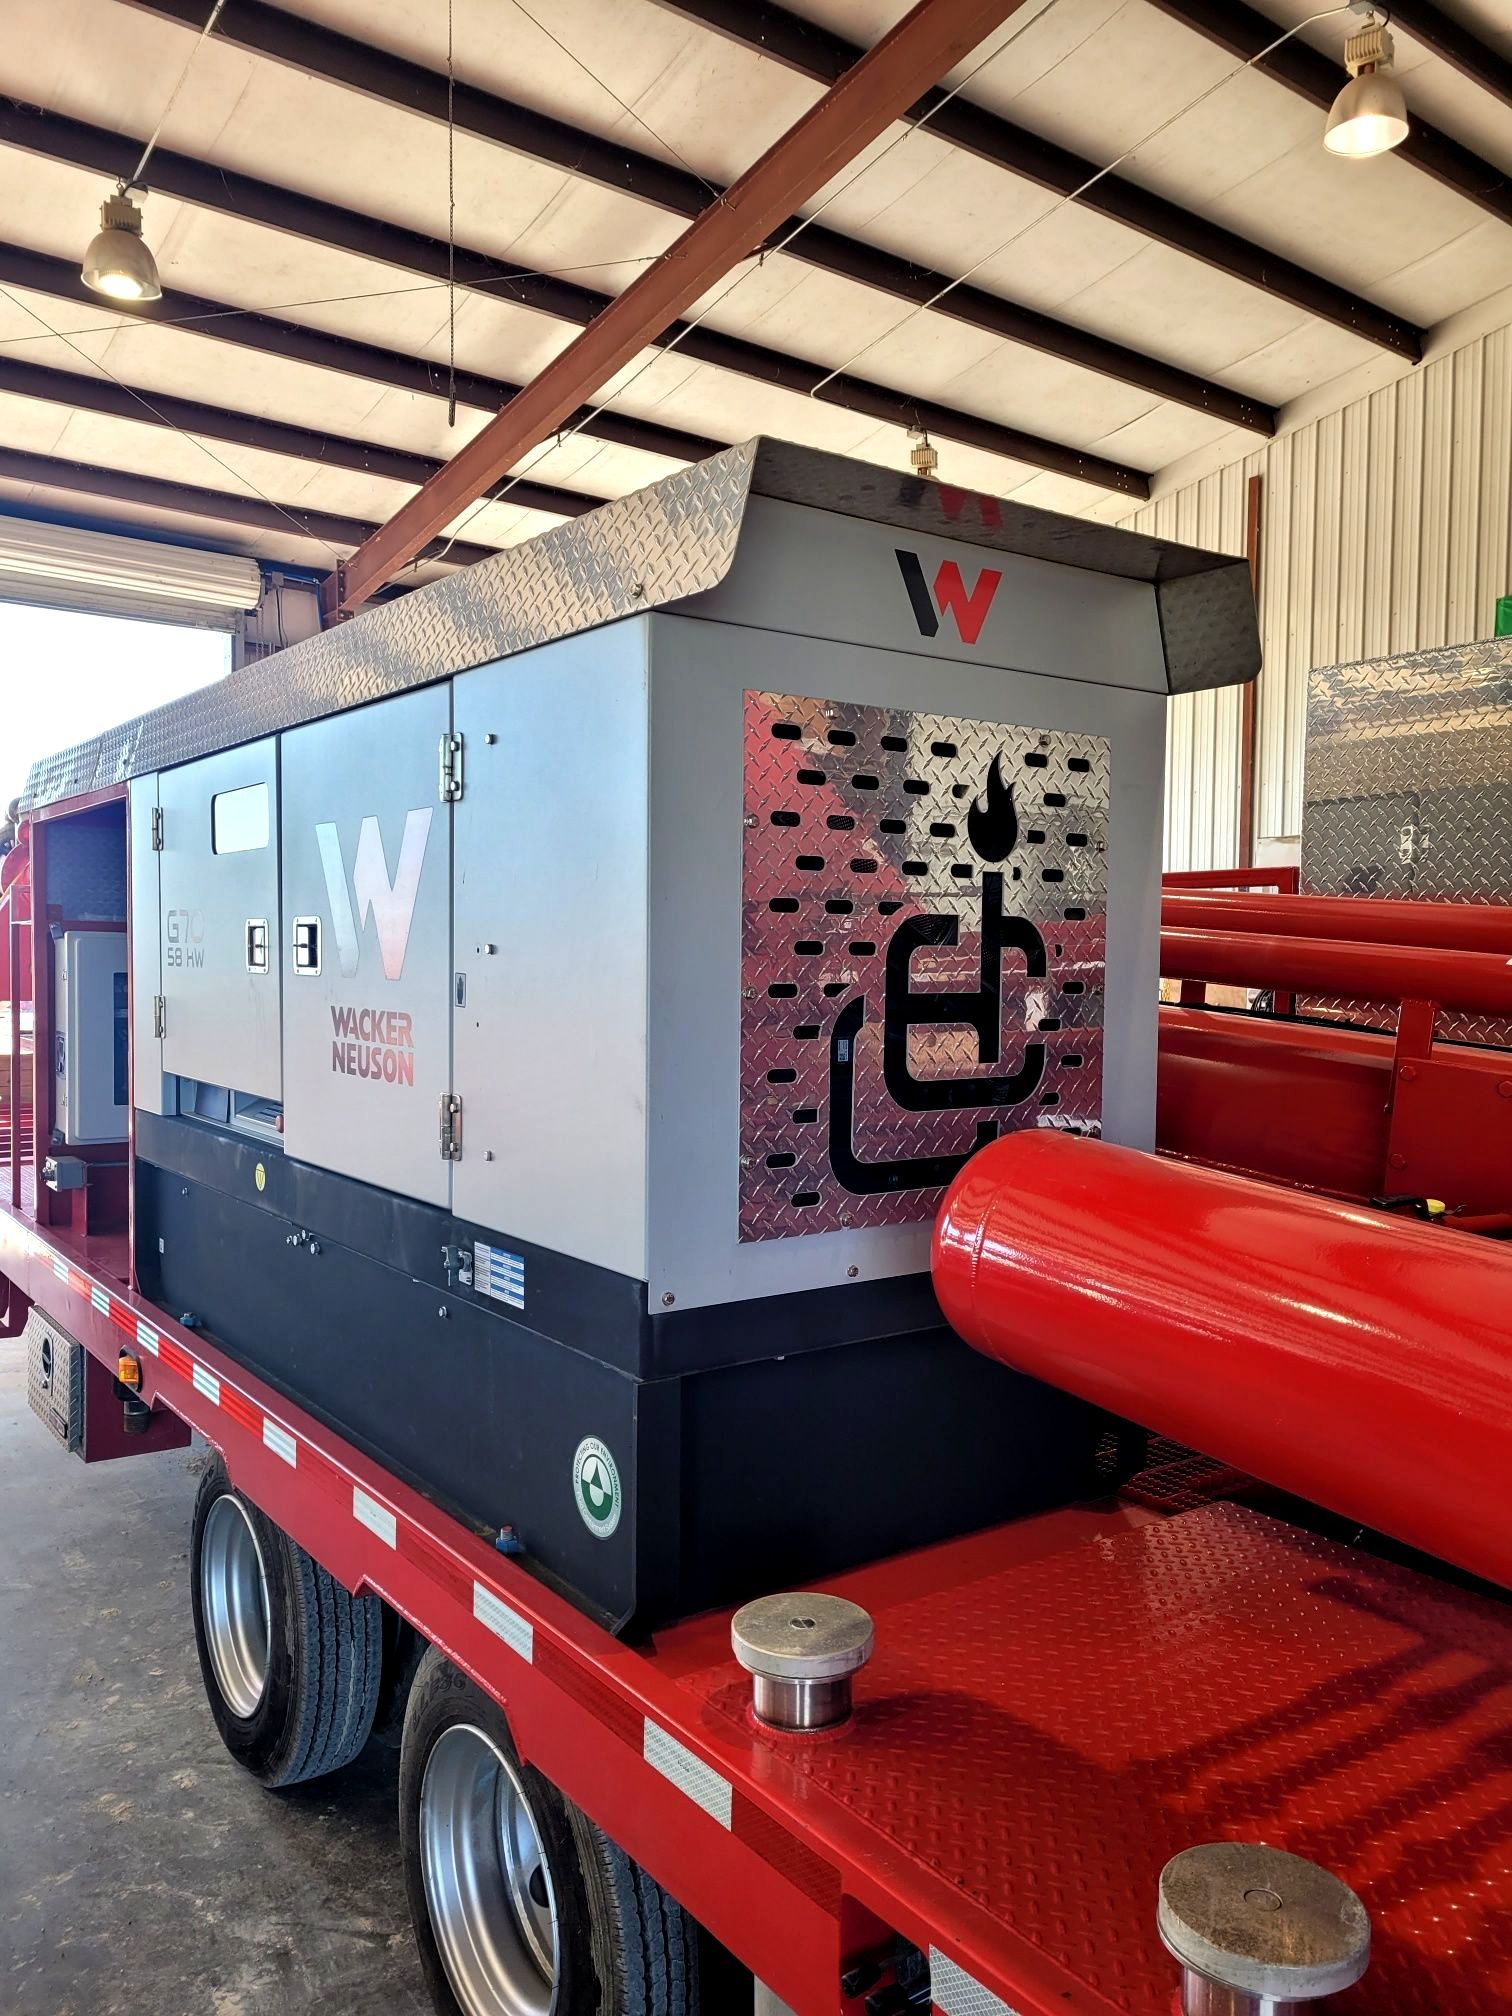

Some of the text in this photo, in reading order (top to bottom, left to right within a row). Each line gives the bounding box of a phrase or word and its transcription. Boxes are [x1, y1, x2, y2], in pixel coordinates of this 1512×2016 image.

[167, 947, 182, 967] 58
[330, 1005, 414, 1048] WACKER
[332, 1040, 414, 1087] NEUSON
[575, 1441, 620, 1507] PROTECTING OUR ENVIRONMENT
